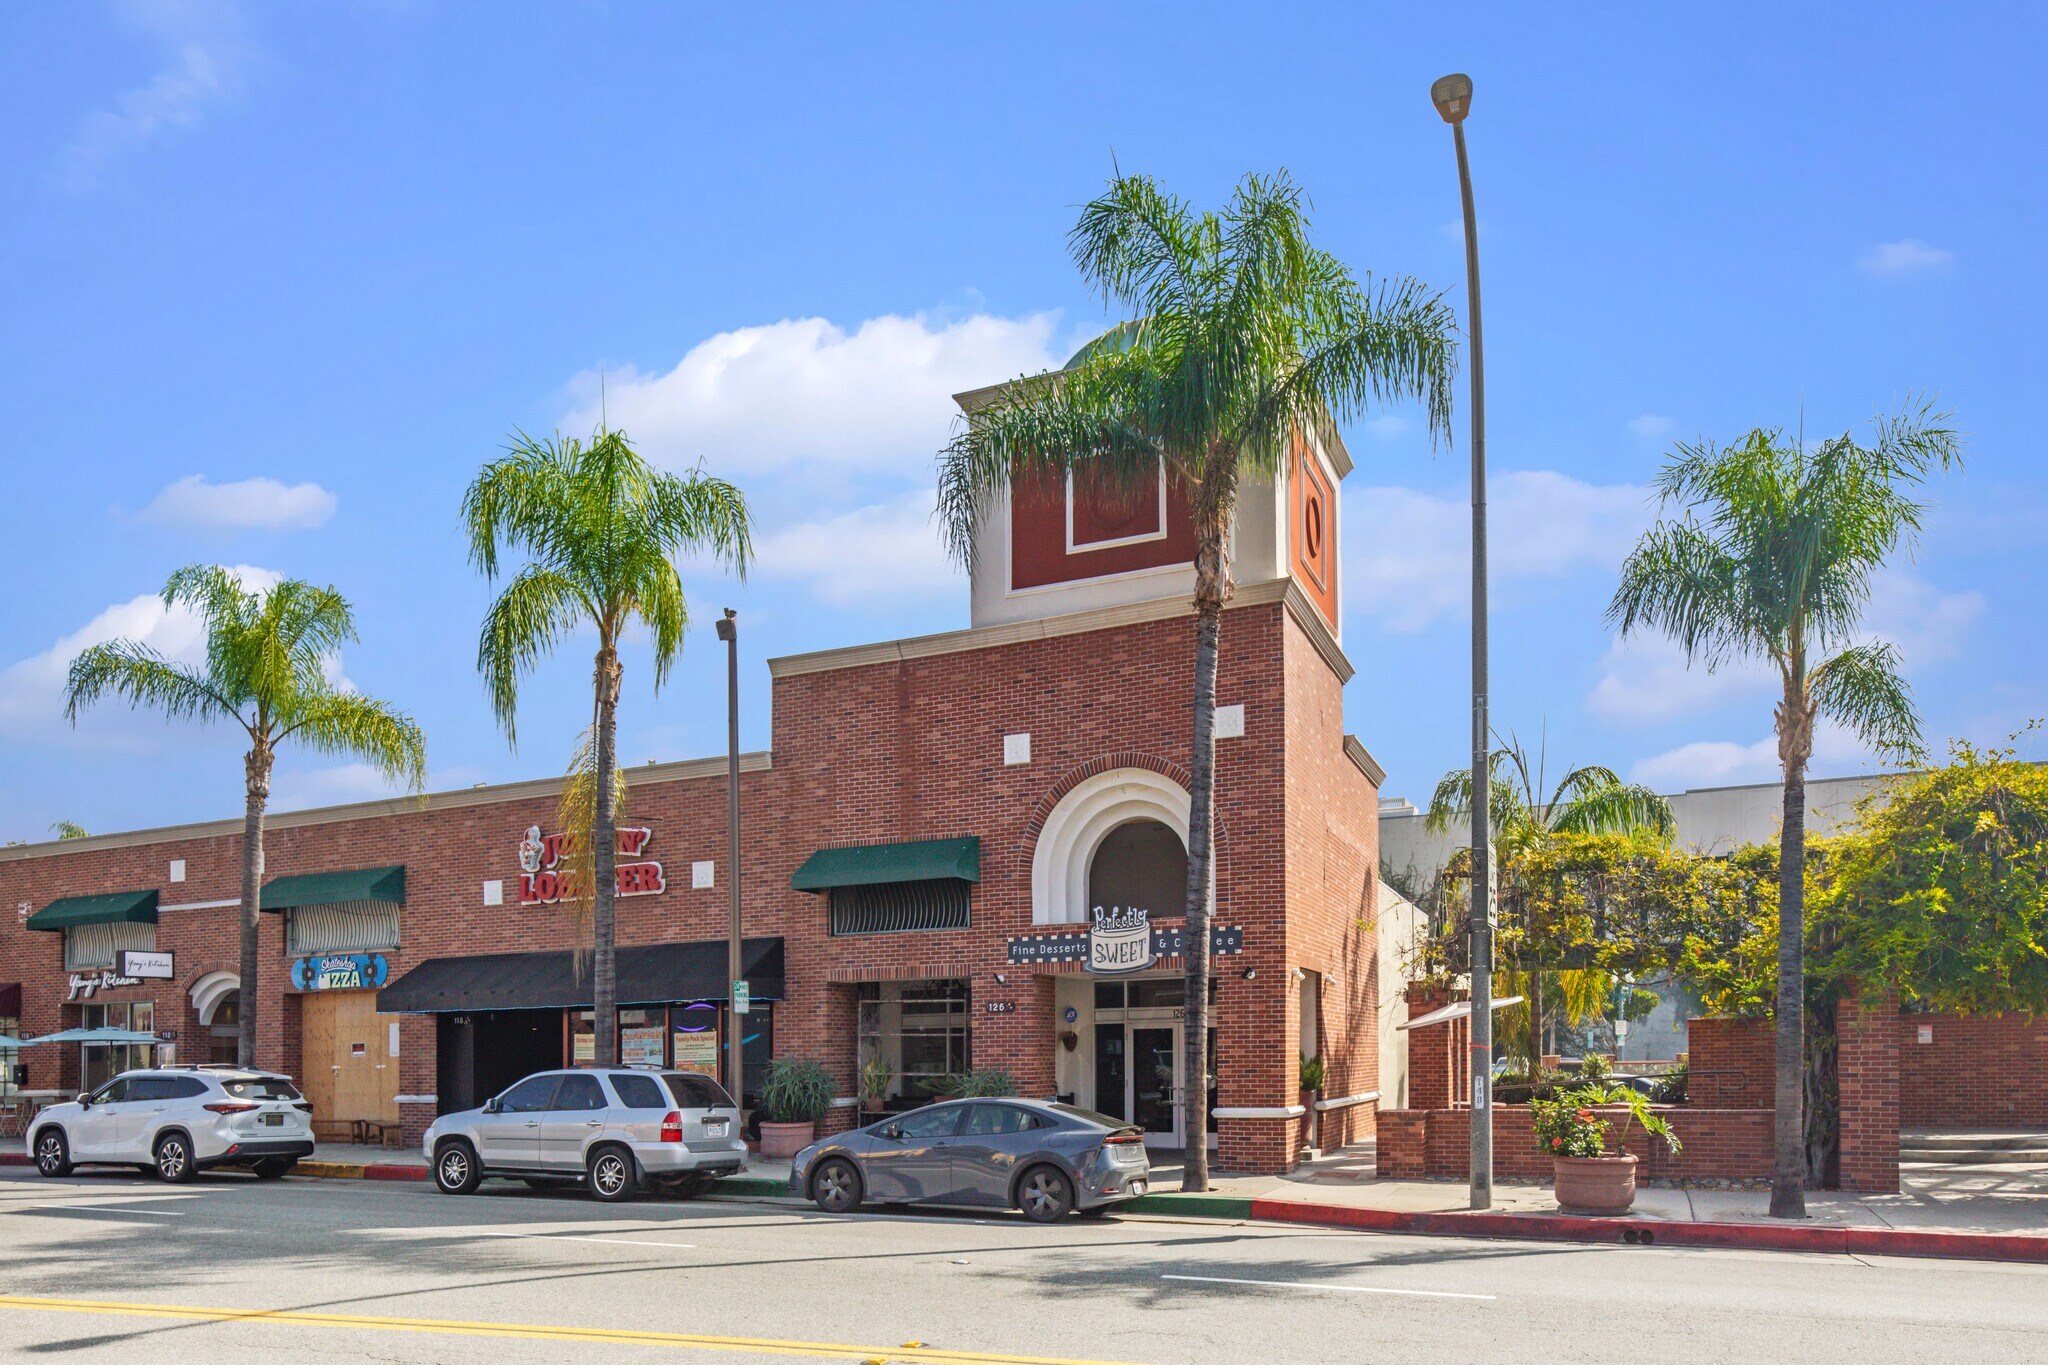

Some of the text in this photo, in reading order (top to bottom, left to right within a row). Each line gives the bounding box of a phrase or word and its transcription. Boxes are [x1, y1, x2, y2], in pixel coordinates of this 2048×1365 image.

[518, 862, 665, 905] LOBER
[1093, 906, 1148, 932] Perfectly
[1012, 937, 1234, 955] Fine Desserts & Cee
[1094, 938, 1147, 964] SWEET
[128, 959, 170, 971] Yang's Kitchen
[321, 956, 357, 971] Skateshop
[68, 974, 101, 1000] Yang's
[988, 1002, 1005, 1012] 126
[1173, 1009, 1185, 1019] 126
